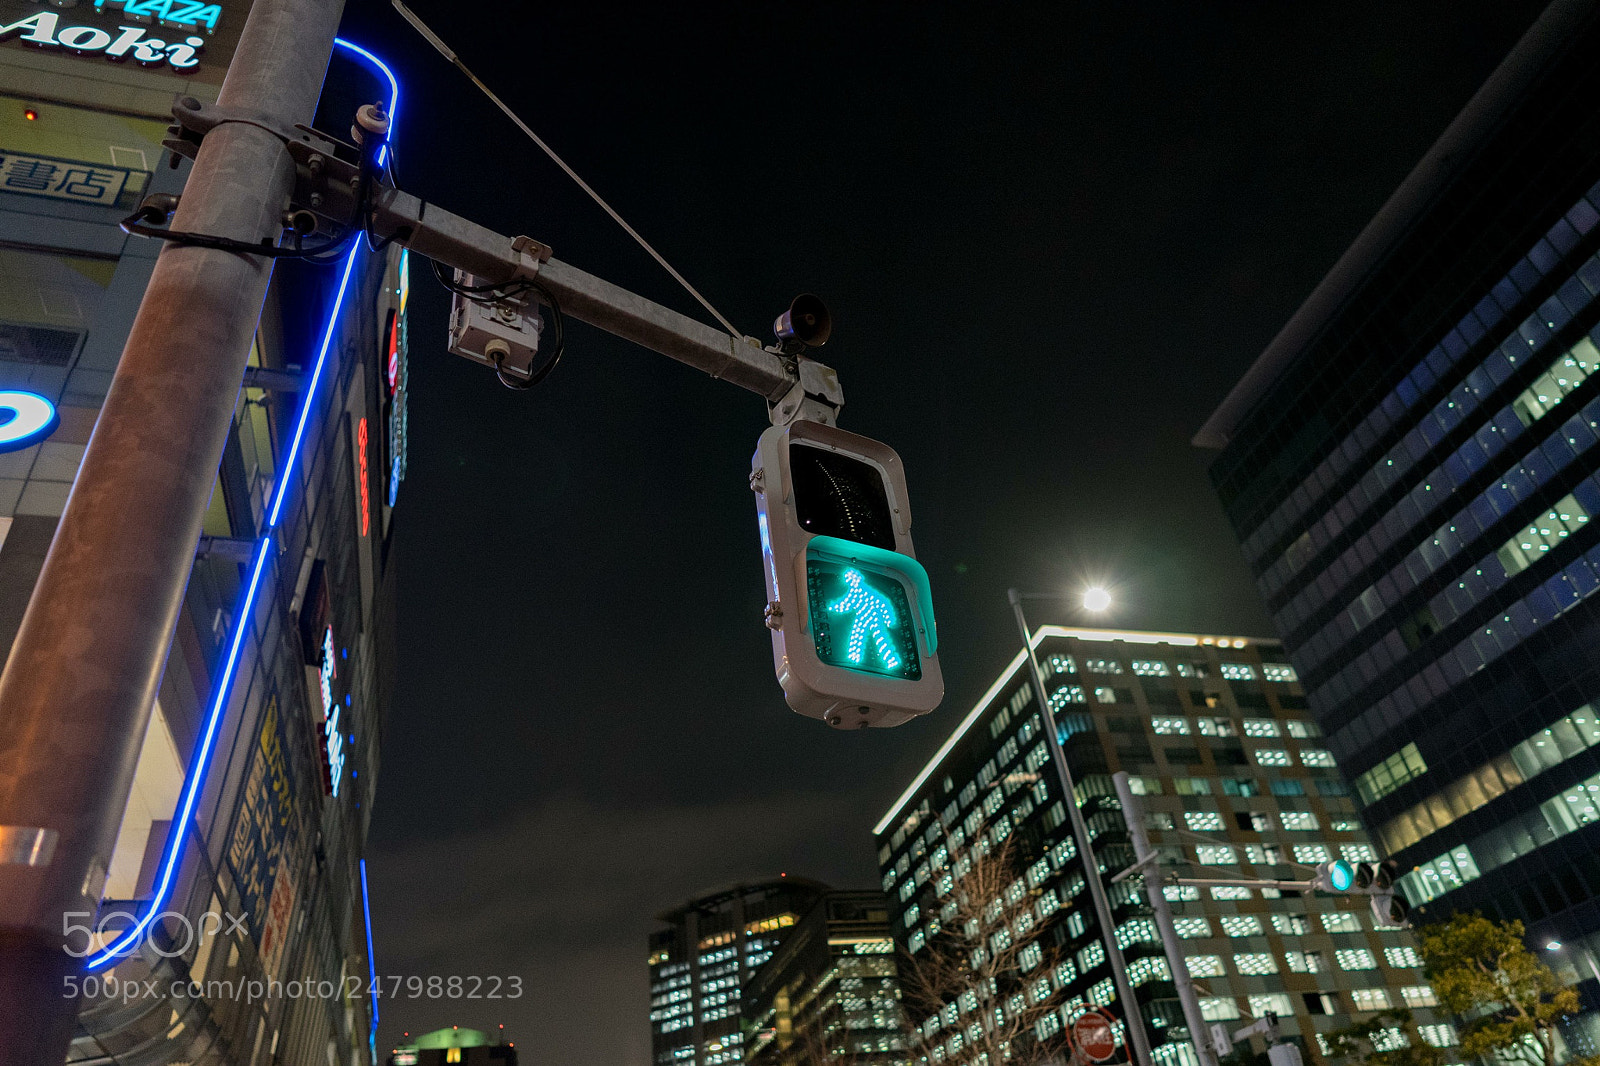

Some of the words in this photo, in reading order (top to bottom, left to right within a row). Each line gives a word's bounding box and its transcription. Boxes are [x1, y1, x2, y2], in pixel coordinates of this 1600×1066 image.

[94, 0, 222, 28] LAZA
[0, 11, 205, 67] Aoki
[0, 157, 114, 198] 書店
